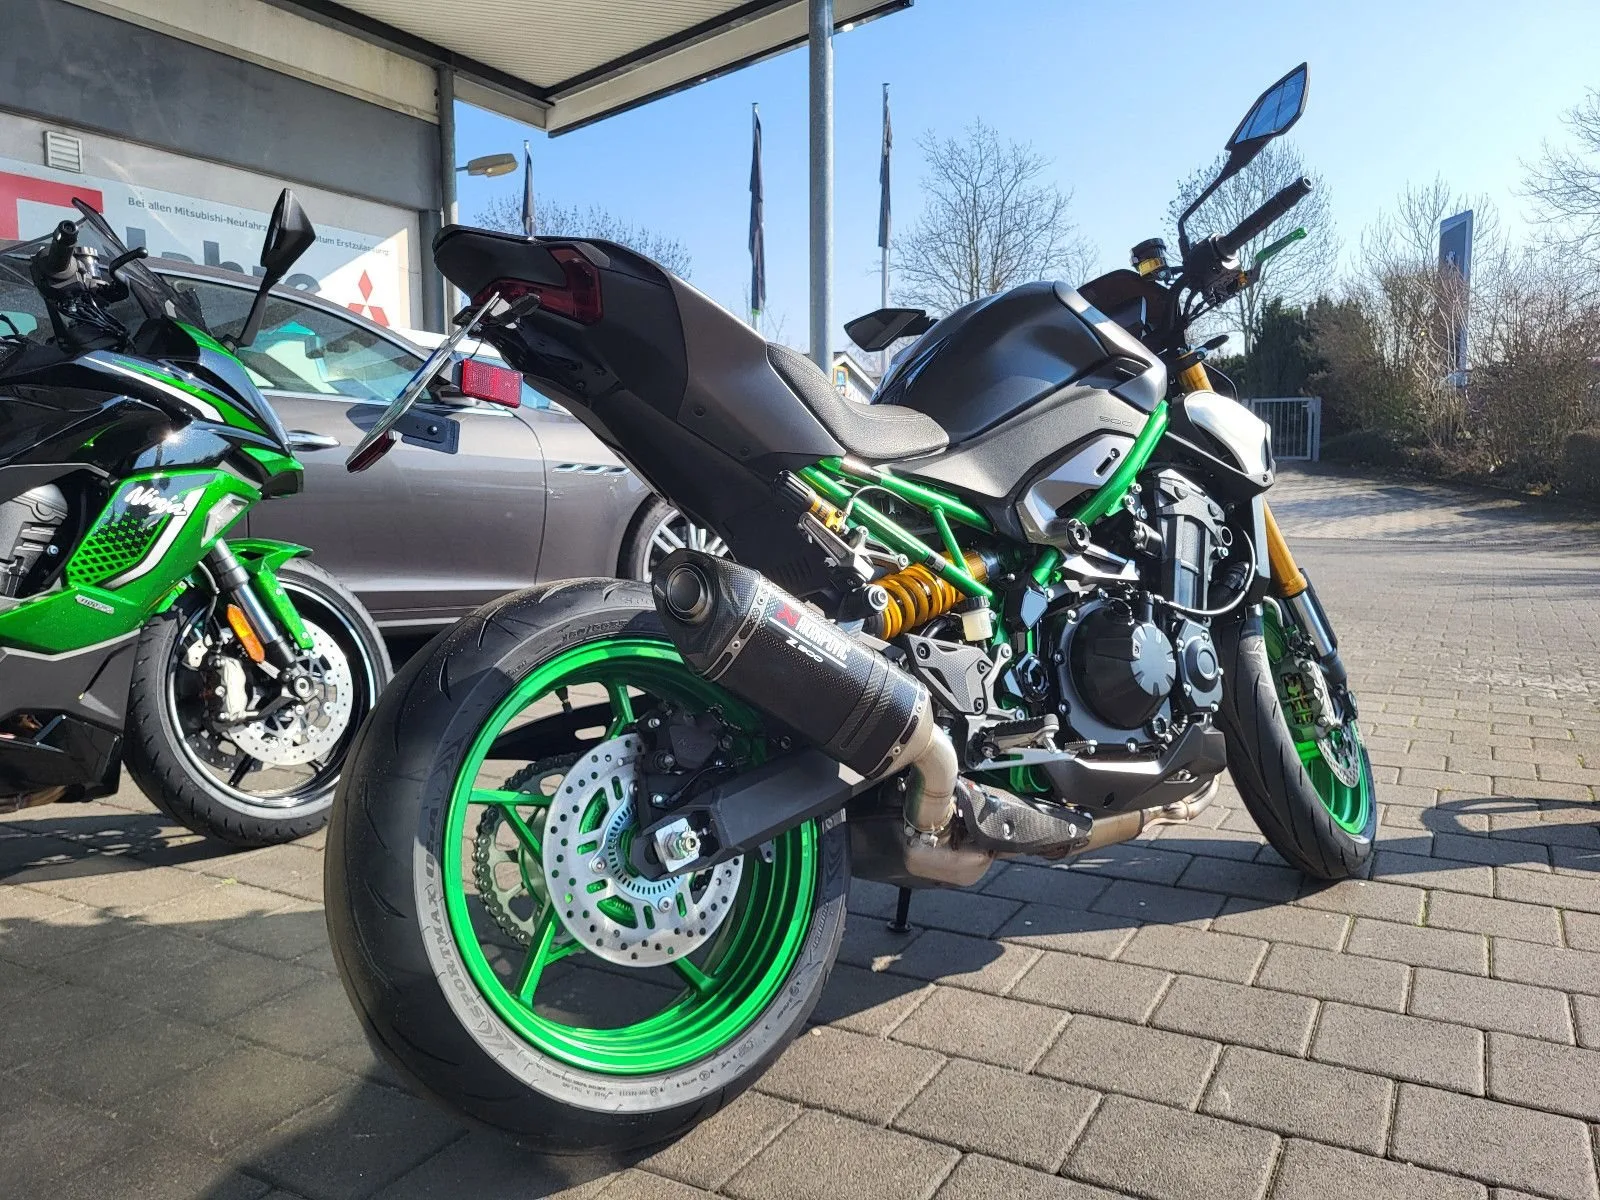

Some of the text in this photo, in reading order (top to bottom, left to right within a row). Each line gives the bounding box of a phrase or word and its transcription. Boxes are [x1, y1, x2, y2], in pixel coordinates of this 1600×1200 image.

[128, 197, 145, 208] Bei
[148, 201, 172, 213] allen
[174, 206, 267, 231] Mitsubishi-Neufahrz
[124, 485, 187, 516] Ninja
[426, 886, 487, 1019] SPORTMAX
